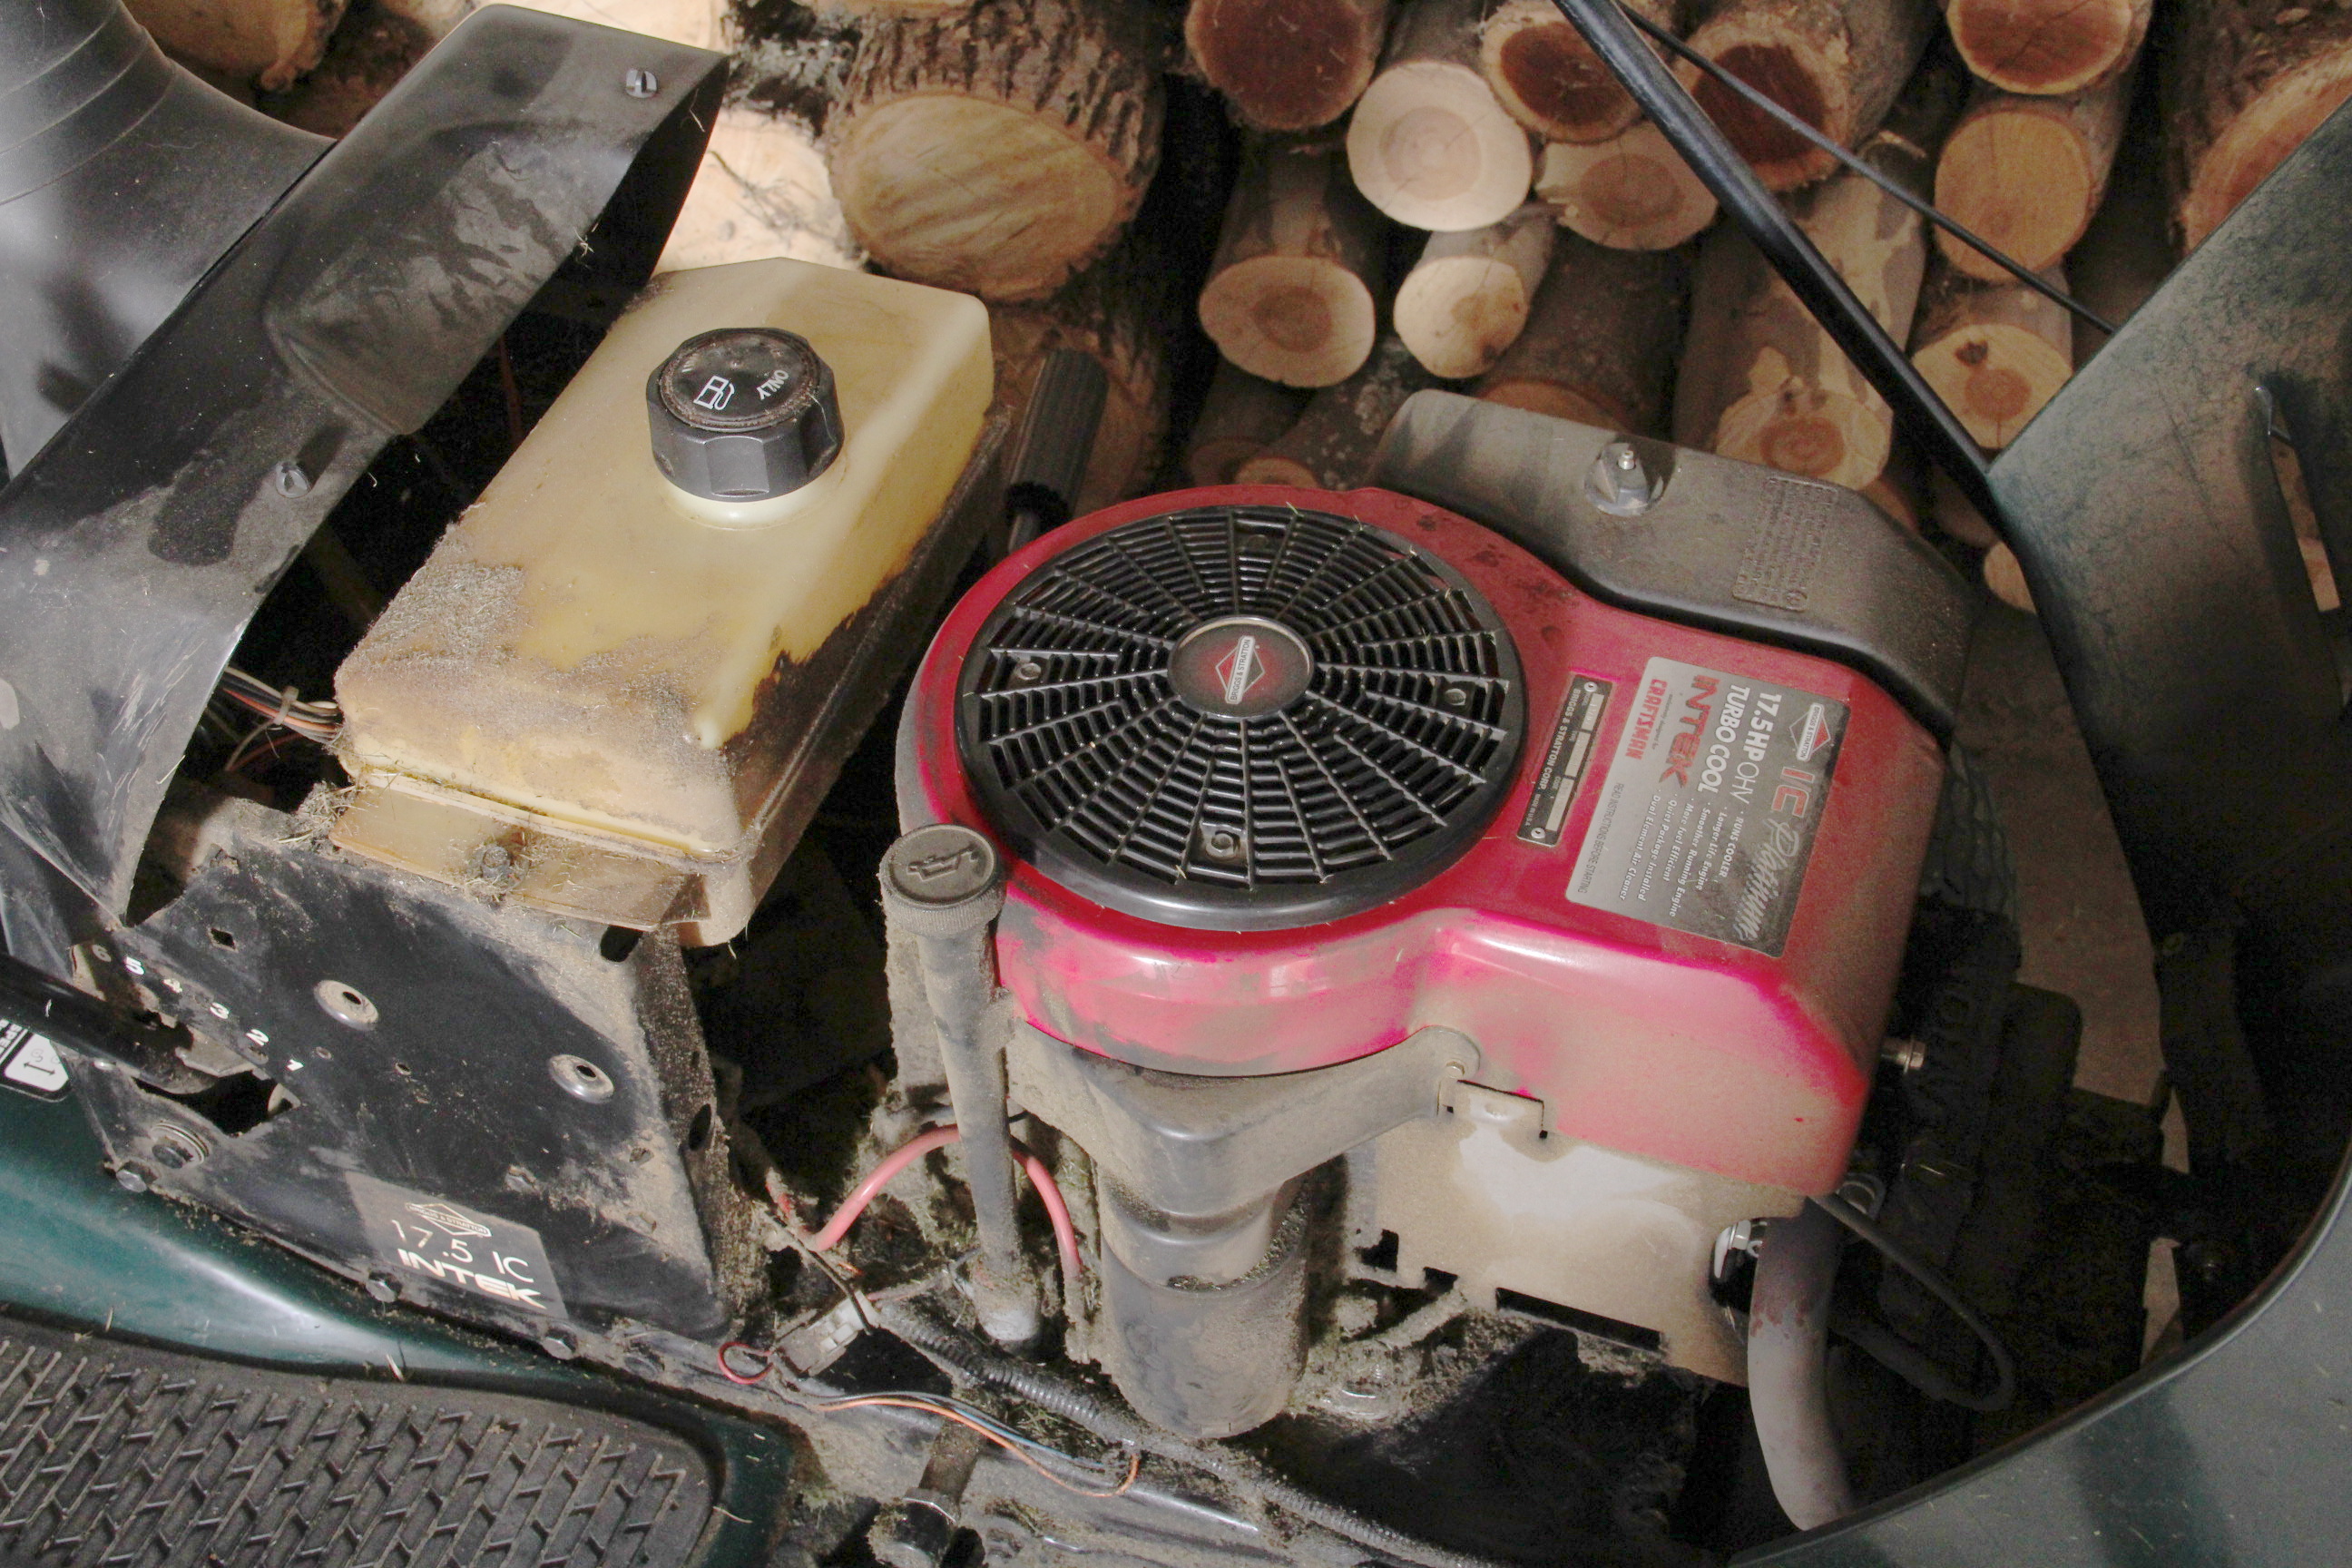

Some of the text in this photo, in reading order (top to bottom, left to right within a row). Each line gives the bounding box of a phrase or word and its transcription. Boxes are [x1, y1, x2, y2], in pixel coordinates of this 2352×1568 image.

[757, 370, 789, 400] ONLY
[1230, 678, 1241, 700] BRIGGS
[1238, 640, 1250, 670] STRATTON
[1563, 688, 1581, 716] BRIGGS
[1625, 678, 1667, 760] CRAFTSMAN
[1659, 673, 1720, 789] INTEK
[1809, 707, 1819, 726] BRIGGS
[1545, 725, 1568, 766] STRATTON
[1696, 683, 1749, 795] TURBO COOL
[1800, 732, 1813, 758] STRATTON
[1537, 766, 1553, 790] CORP.
[1728, 760, 1759, 804] OHV
[1578, 782, 1622, 894] READ INSTRUCTIONS BEFORE STARTING
[1681, 803, 1692, 826] More
[1619, 794, 1660, 901] Dual Element Air Cleaner
[1638, 799, 1676, 901] Quiet Package Installed
[1662, 845, 1679, 882] Efficient
[1669, 808, 1709, 917] Smoother Running Engine
[1696, 811, 1725, 891] Longer Life Engine
[1720, 817, 1742, 877] RUNS COOLER
[1731, 817, 1800, 946] Platinum
[92, 945, 304, 1072] 6 5 4 3 2 1
[392, 1220, 534, 1282] 17.5 IC
[397, 1249, 546, 1309] INTEK
